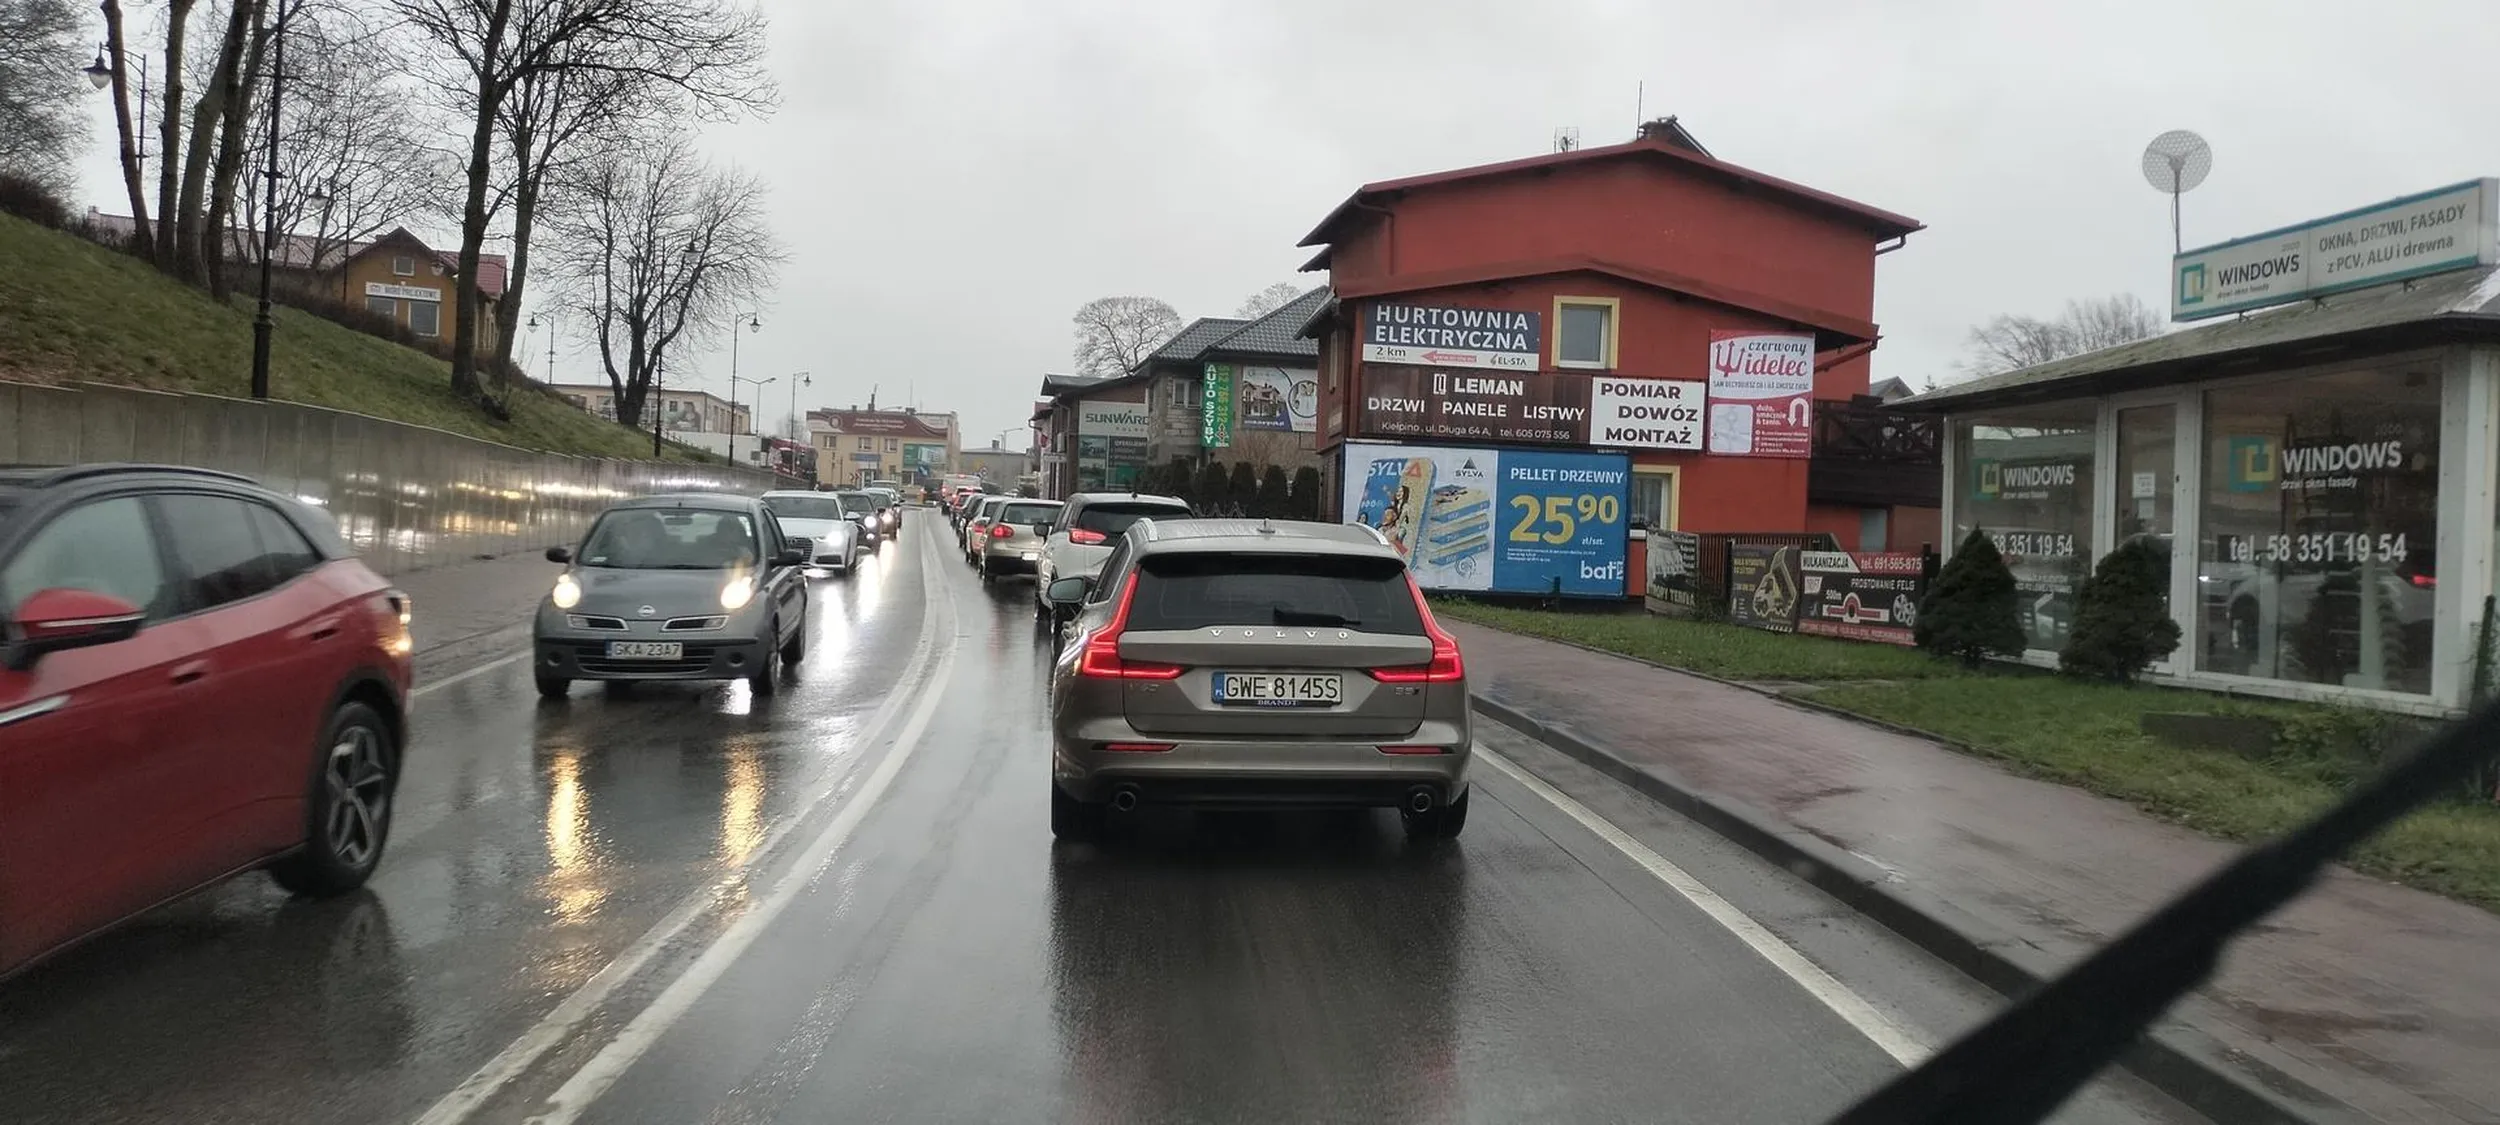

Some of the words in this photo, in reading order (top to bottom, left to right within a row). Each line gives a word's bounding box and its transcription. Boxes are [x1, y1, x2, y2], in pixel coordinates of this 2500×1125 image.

[2319, 231, 2358, 252] OKNA,
[2361, 219, 2407, 243] DRZWI,
[2410, 203, 2467, 231] FASADY
[2327, 262, 2334, 273] z
[2336, 252, 2364, 271] PCV,
[2367, 245, 2394, 265] ALU
[2396, 246, 2400, 259] i
[2403, 235, 2454, 257] drewna
[2218, 254, 2300, 287] WINDOWS
[1376, 304, 1529, 331] HURTOWNIA
[1375, 325, 1528, 350] ELEKTRYCZNA
[1748, 341, 1807, 356] czerwony
[1376, 347, 1384, 355] 2
[1387, 346, 1406, 357] km
[1206, 364, 1217, 398] AUTO
[1454, 377, 1524, 396] LEMAN
[1600, 383, 1681, 399] POMIAR
[1367, 397, 1425, 413] DRZWI
[1442, 402, 1507, 417] PANELE
[1523, 405, 1585, 421] LISTWY
[1618, 404, 1698, 422] DOWÓZ
[1204, 401, 1215, 444] SZYBY
[1426, 424, 1436, 434] ul.
[1438, 424, 1466, 437] Długa
[1468, 426, 1480, 436] 64
[1500, 428, 1514, 438] tel.
[1516, 429, 1533, 438] 605
[1535, 430, 1551, 439] 075
[1553, 430, 1570, 440] 556
[1605, 426, 1691, 444] MONTAŻ
[2282, 441, 2402, 474] WINDOWS
[1510, 468, 1556, 481] PELLET
[1560, 470, 1623, 484] DRZEWNY
[2003, 464, 2075, 488] WINDOWS
[2328, 476, 2358, 490] fasady
[1992, 534, 2006, 556] 58
[2009, 534, 2032, 556] 351
[2036, 534, 2053, 556] 19
[2056, 534, 2074, 557] 54
[2229, 534, 2260, 562] tel.
[2266, 534, 2291, 562] 58
[2297, 533, 2334, 562] 351
[2344, 533, 2371, 562] 19
[2378, 533, 2408, 563] 54
[1211, 629, 1348, 639] VOLVO
[1226, 677, 1266, 697] GWE
[1273, 677, 1338, 698] 8145S
